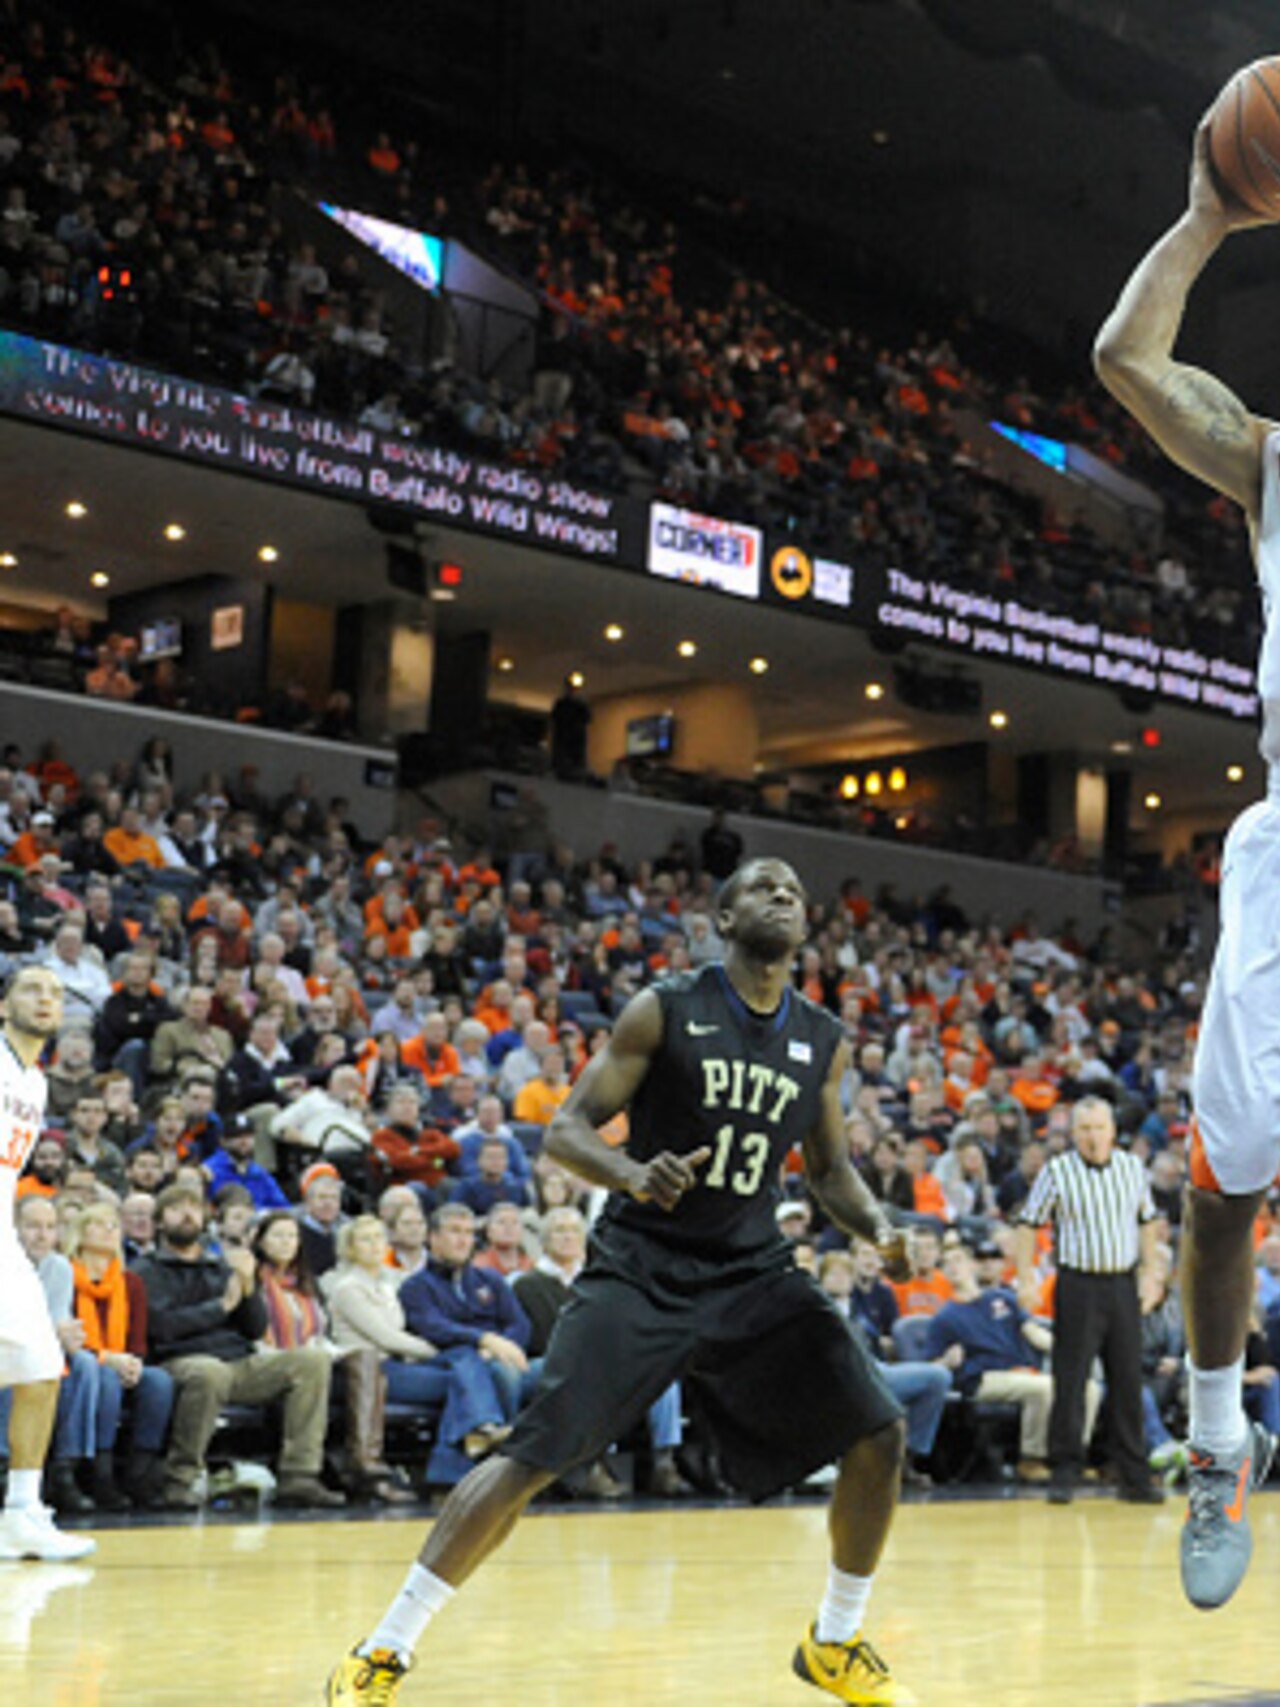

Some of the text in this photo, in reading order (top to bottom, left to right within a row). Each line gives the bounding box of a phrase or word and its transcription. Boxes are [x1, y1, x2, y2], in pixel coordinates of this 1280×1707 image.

[180, 425, 231, 456] you
[240, 428, 291, 471] live
[296, 448, 364, 490] from
[369, 467, 463, 515] Buffalo
[468, 493, 528, 531] Wild
[477, 463, 543, 501] radio
[547, 480, 613, 518] show
[701, 1058, 801, 1123] PITT
[705, 1124, 769, 1195] 13
